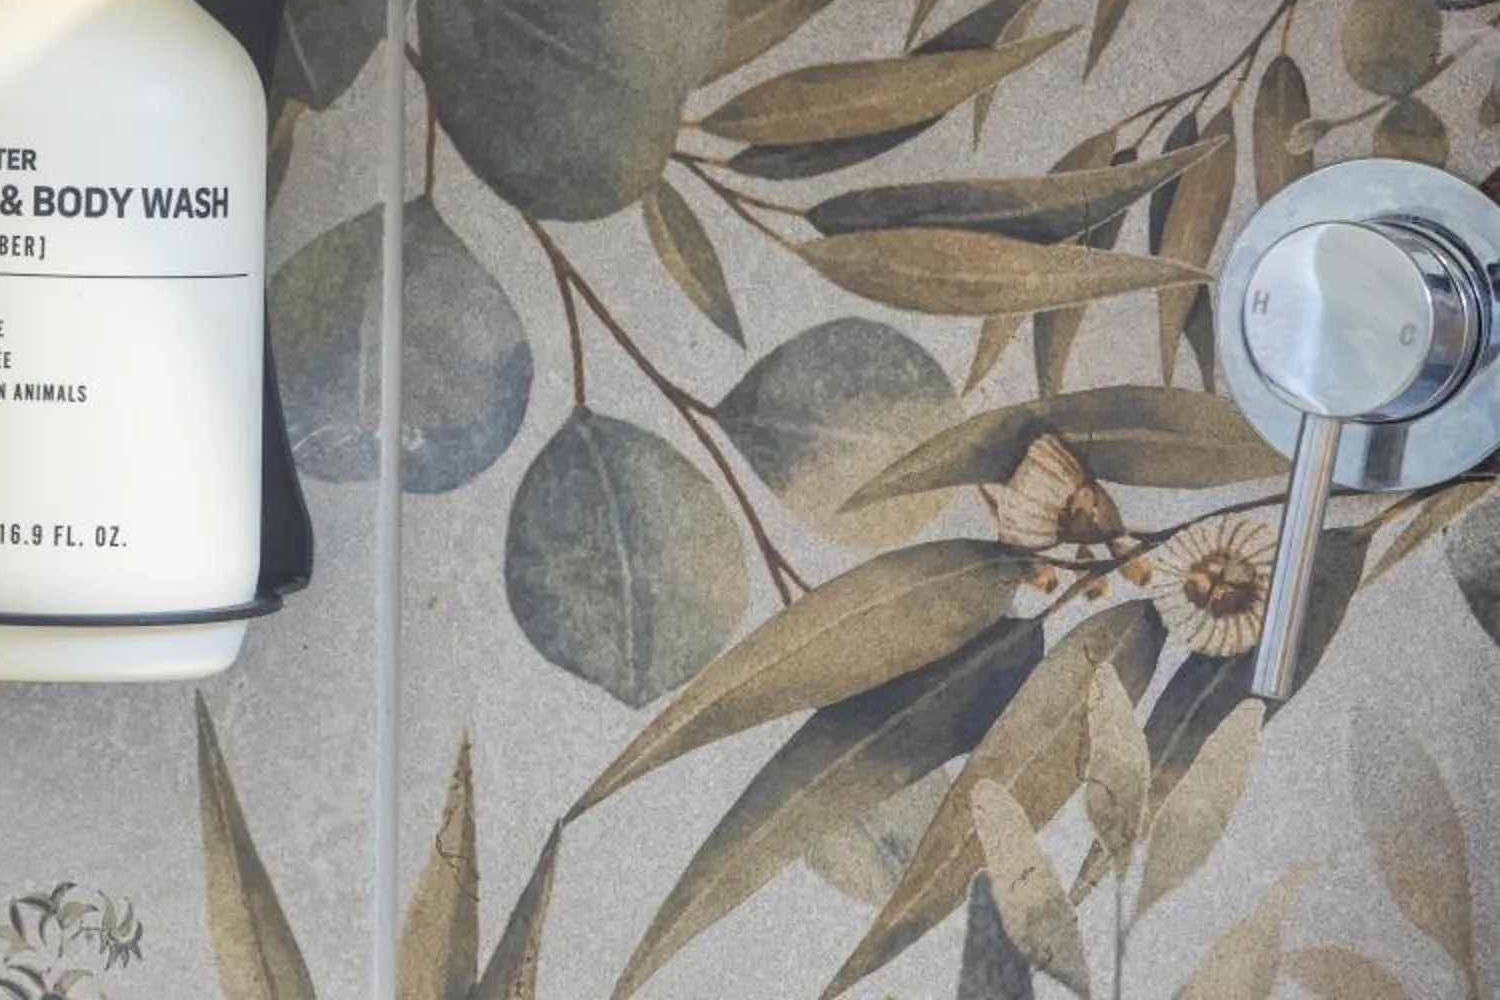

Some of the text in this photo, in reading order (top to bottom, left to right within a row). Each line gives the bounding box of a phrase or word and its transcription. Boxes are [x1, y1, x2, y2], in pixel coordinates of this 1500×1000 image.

[0, 185, 22, 216] &
[33, 184, 133, 219] BODY
[142, 187, 228, 219] WASH
[1252, 290, 1269, 315] H
[1400, 324, 1416, 346] C
[14, 383, 87, 402] ANIMALS
[54, 525, 83, 547] FL.
[96, 526, 127, 548] OZ.
